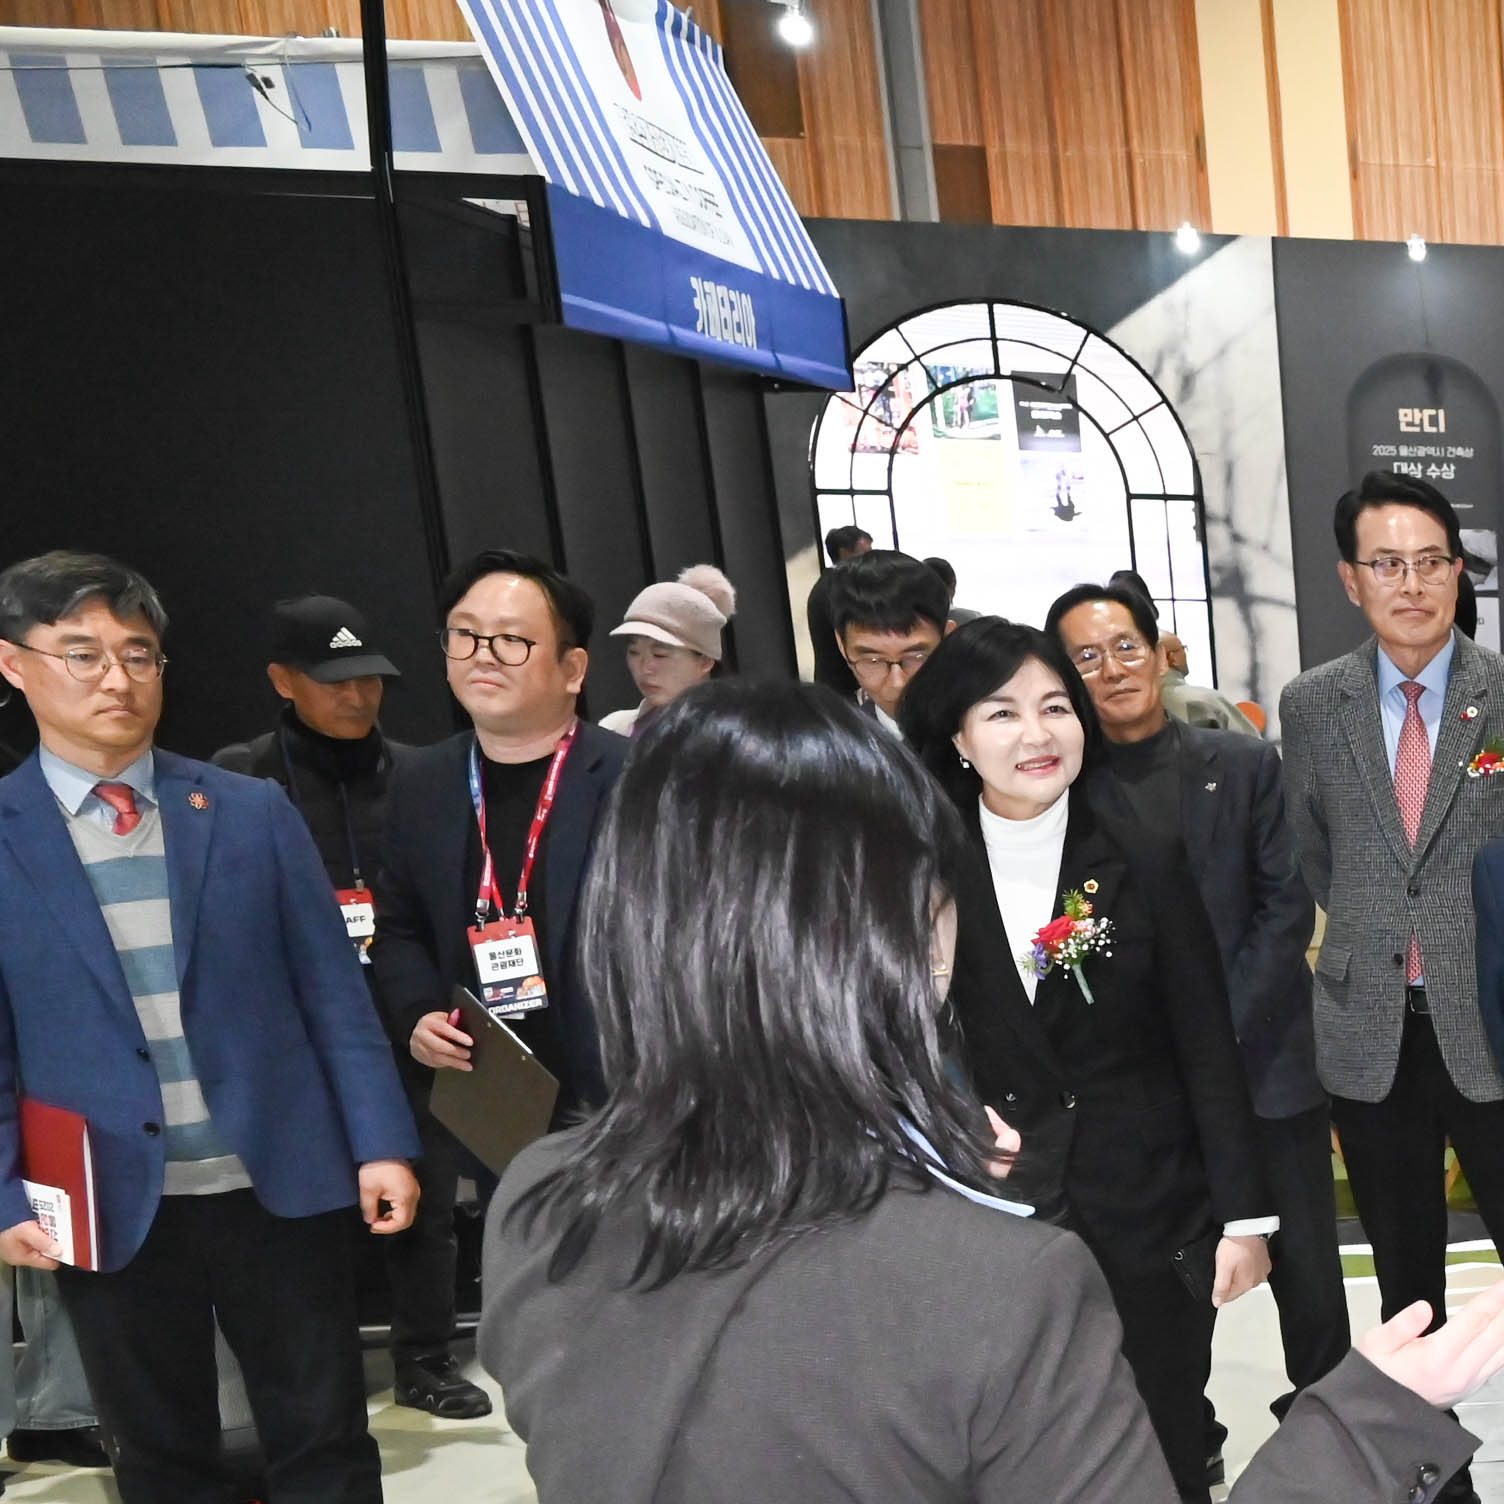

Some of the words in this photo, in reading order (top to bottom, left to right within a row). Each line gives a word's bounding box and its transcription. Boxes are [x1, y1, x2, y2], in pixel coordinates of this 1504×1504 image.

[1398, 408, 1446, 432] 만디
[1372, 445, 1397, 456] 2025
[1399, 445, 1444, 457] 울산광역시
[1393, 462, 1422, 478] 대상
[1426, 462, 1456, 479] 수상
